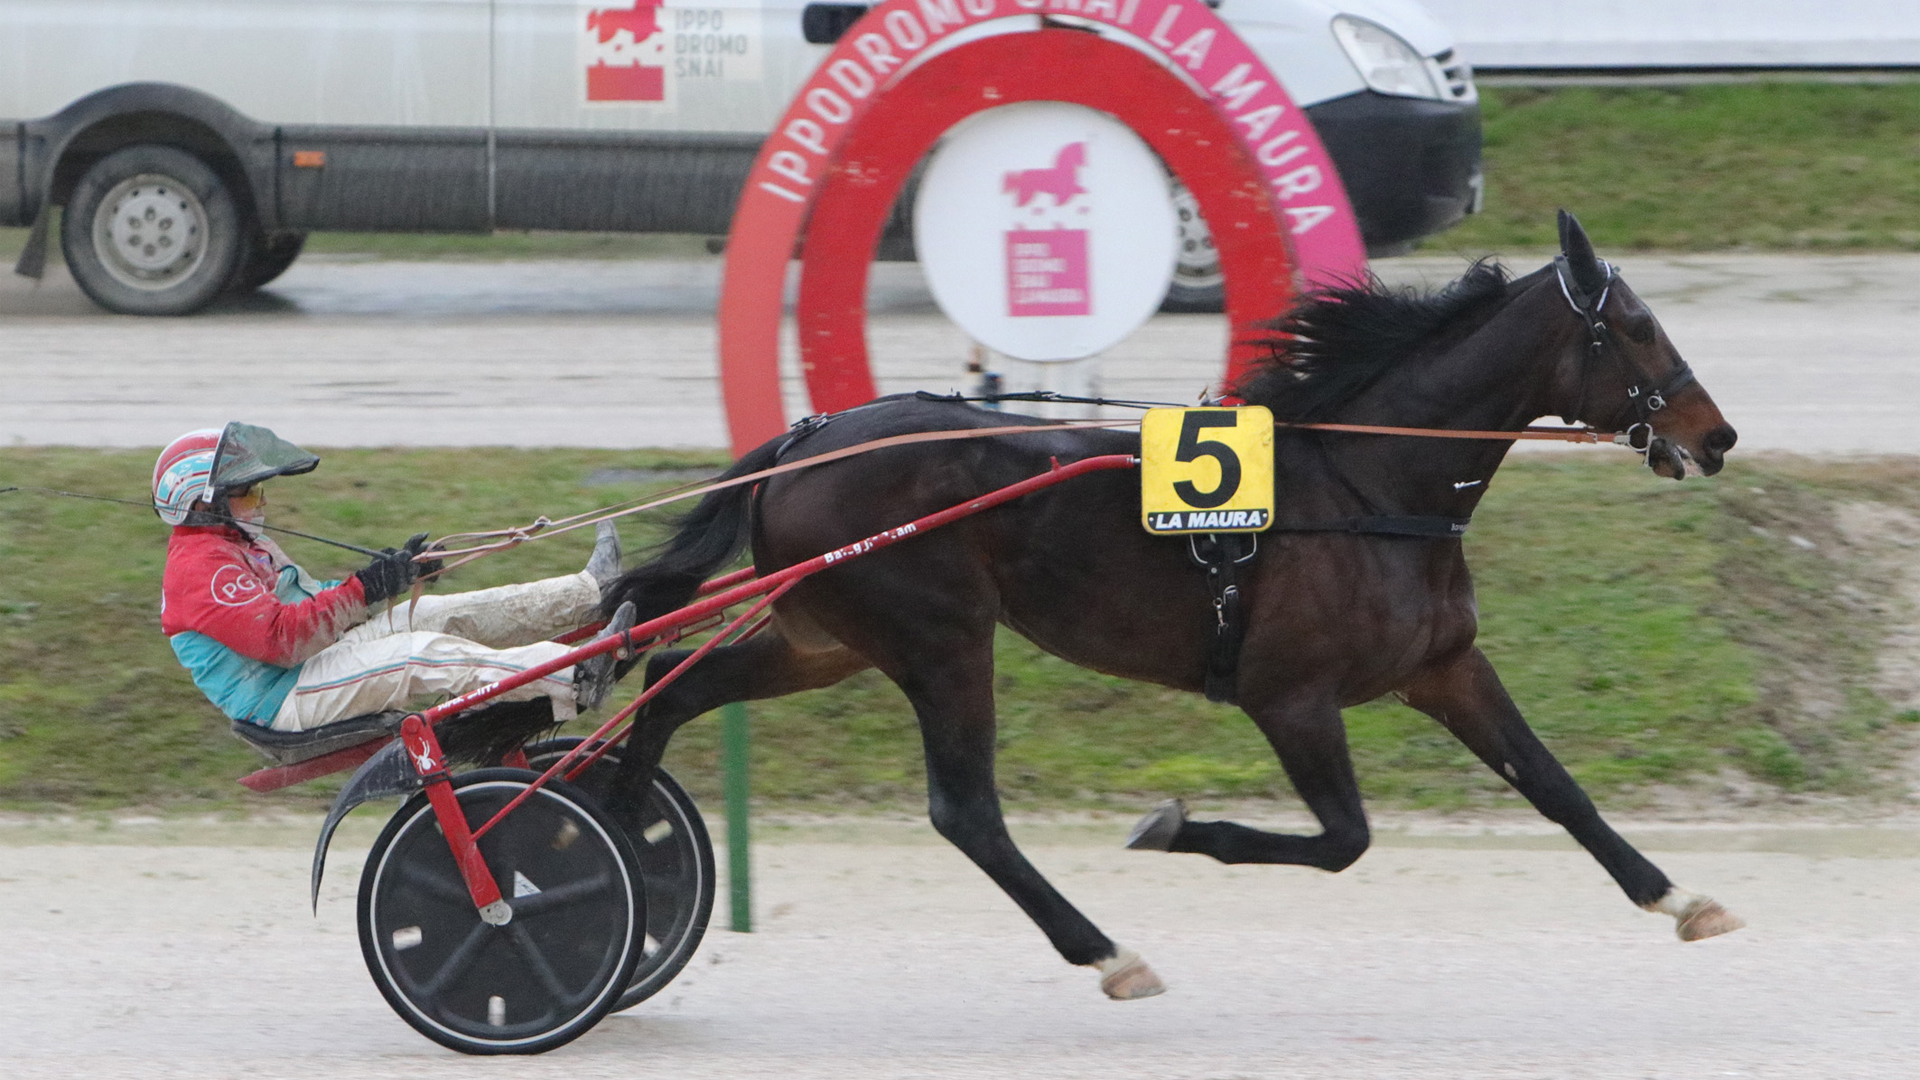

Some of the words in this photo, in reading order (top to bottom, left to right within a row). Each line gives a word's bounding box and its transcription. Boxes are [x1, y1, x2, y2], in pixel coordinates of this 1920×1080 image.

[674, 9, 724, 31] IPPO
[674, 33, 749, 55] DROMO
[674, 56, 724, 78] SNAI
[1150, 4, 1217, 70] LA
[1210, 62, 1337, 235] MAURA
[1172, 410, 1242, 509] 5
[1154, 512, 1183, 530] LA
[1187, 510, 1262, 529] MAURA
[221, 572, 257, 599] PG
